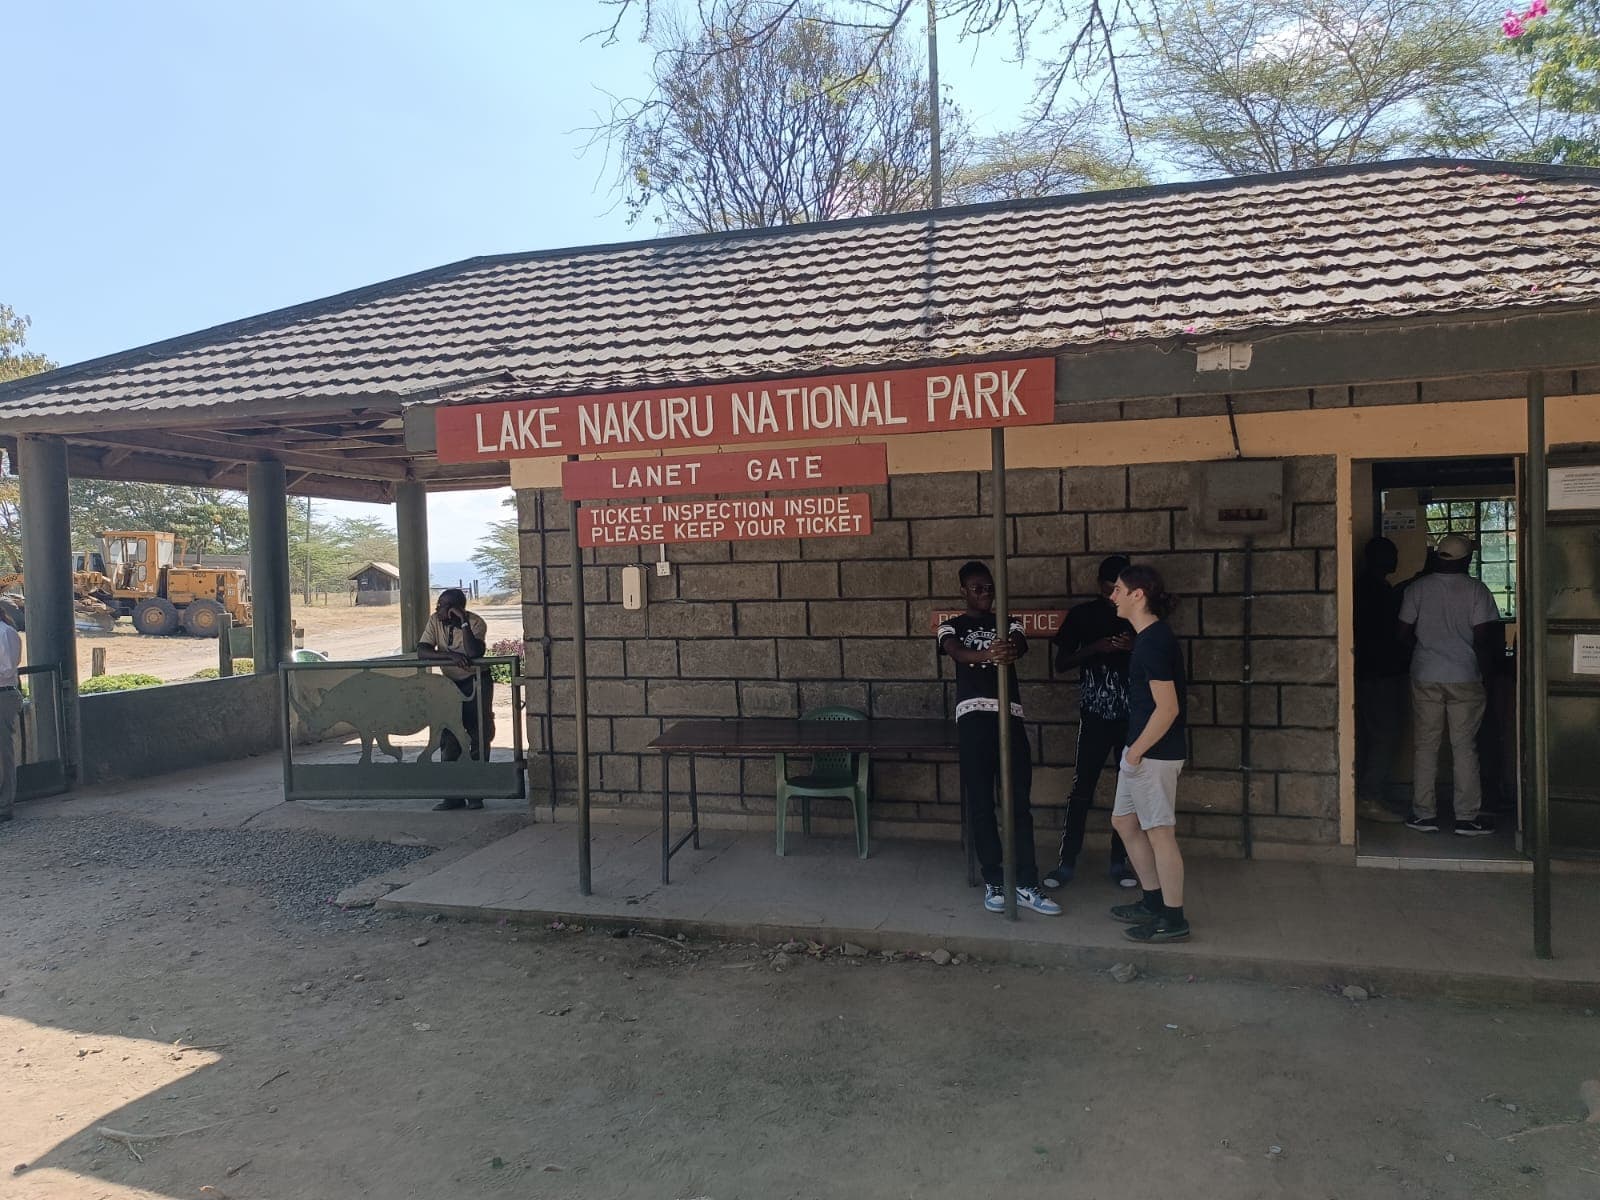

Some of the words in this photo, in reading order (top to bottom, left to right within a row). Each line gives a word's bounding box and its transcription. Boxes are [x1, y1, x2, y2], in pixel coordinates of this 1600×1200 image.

[475, 407, 562, 452] LAKE
[578, 395, 714, 446] NAKURU
[731, 380, 907, 435] NATIONAL
[926, 368, 1027, 422] PARK
[611, 463, 701, 489] LANET
[747, 455, 822, 481] GATE
[590, 506, 652, 525] TICKET
[662, 501, 774, 521] INSPECTION
[784, 497, 850, 516] INSIDE
[591, 524, 664, 543] PLEASE
[674, 521, 725, 539] KEEP
[734, 519, 786, 537] YOUR
[795, 515, 862, 534] TICKET
